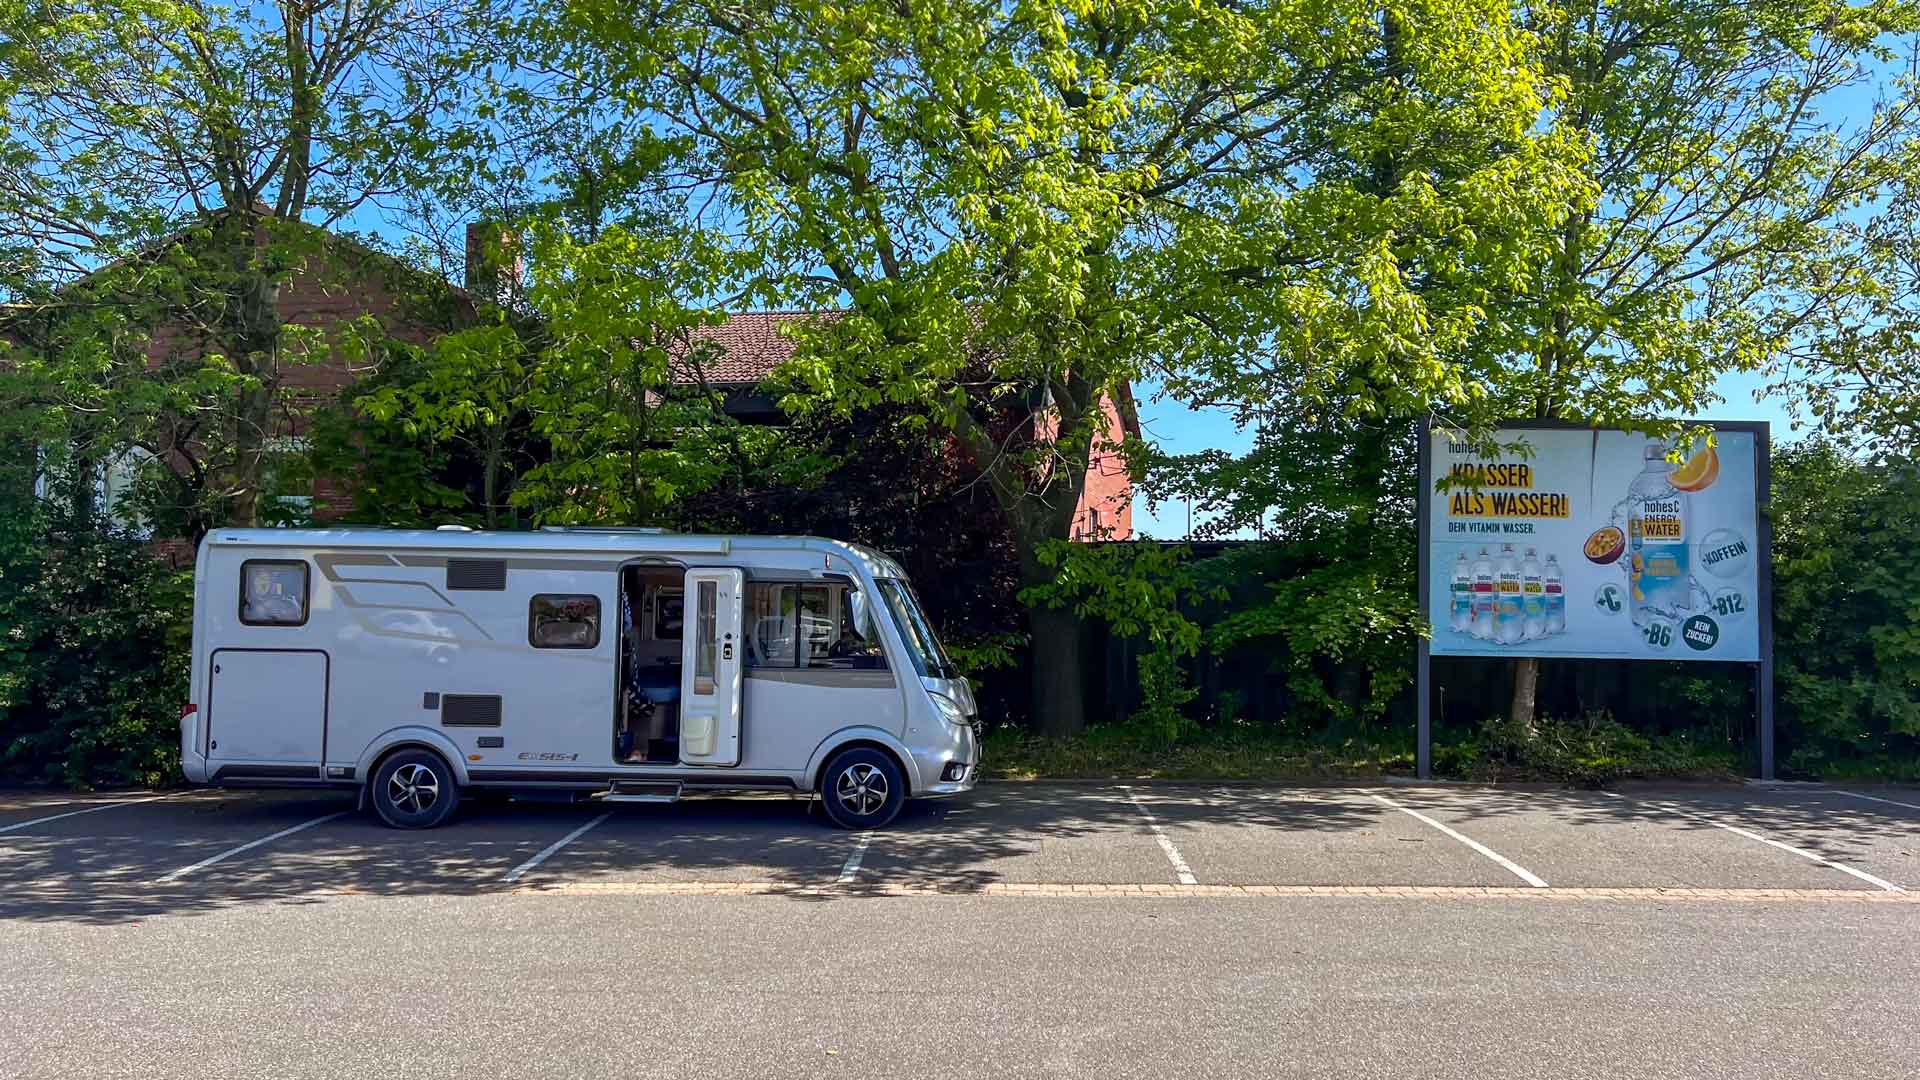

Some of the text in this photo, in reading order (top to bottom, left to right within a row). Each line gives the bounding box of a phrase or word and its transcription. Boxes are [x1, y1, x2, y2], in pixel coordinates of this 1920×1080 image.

[1452, 491, 1567, 516] ALS WASSER!
[1644, 514, 1677, 524] ENERGY
[1448, 521, 1536, 535] DEIN VITAMIN WASSER.
[1644, 523, 1680, 537] WATER
[1694, 620, 1711, 634] KEIN
[1686, 629, 1713, 646] ZUCKER!
